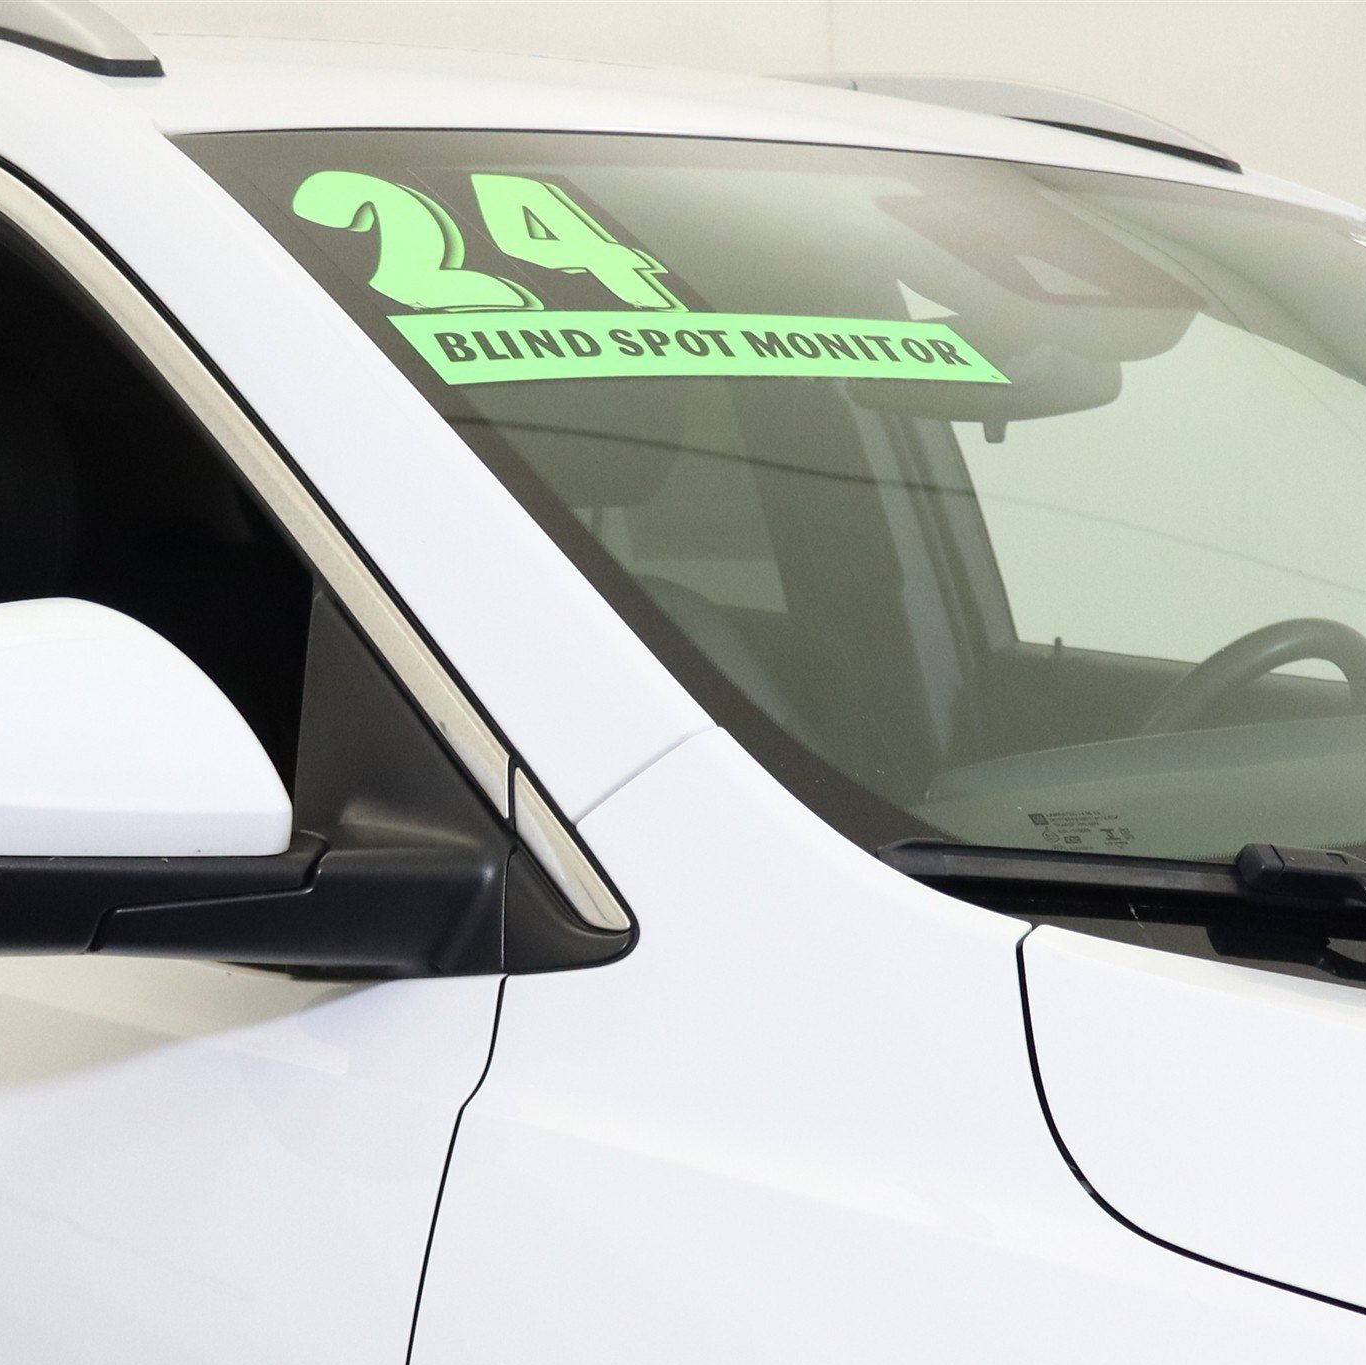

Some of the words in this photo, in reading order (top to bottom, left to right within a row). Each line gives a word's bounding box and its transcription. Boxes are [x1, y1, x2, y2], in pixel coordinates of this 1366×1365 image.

[292, 170, 690, 312] 24
[433, 329, 603, 363] BLIND
[607, 328, 736, 358] SPOT
[739, 329, 973, 367] MONITOR
